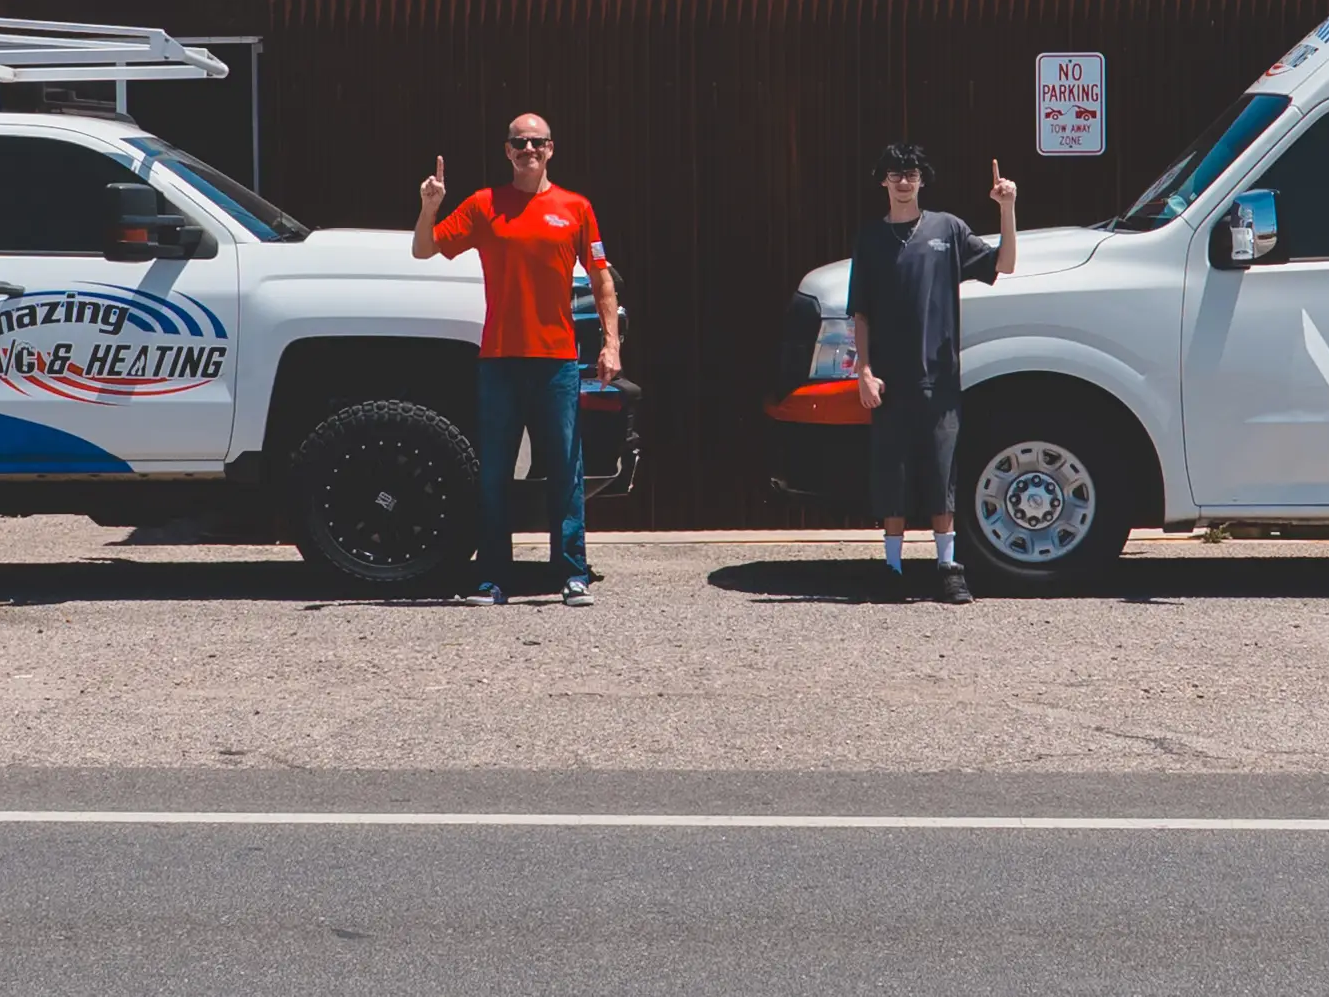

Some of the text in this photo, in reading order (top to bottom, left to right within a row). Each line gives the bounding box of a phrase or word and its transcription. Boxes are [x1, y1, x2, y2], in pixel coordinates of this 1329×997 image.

[1058, 63, 1083, 81] NO
[1042, 83, 1099, 102] PARKING
[1050, 123, 1092, 134] TOW AWAY
[1059, 135, 1083, 146] ZONE
[46, 343, 73, 376] &
[84, 344, 228, 379] HEATING
